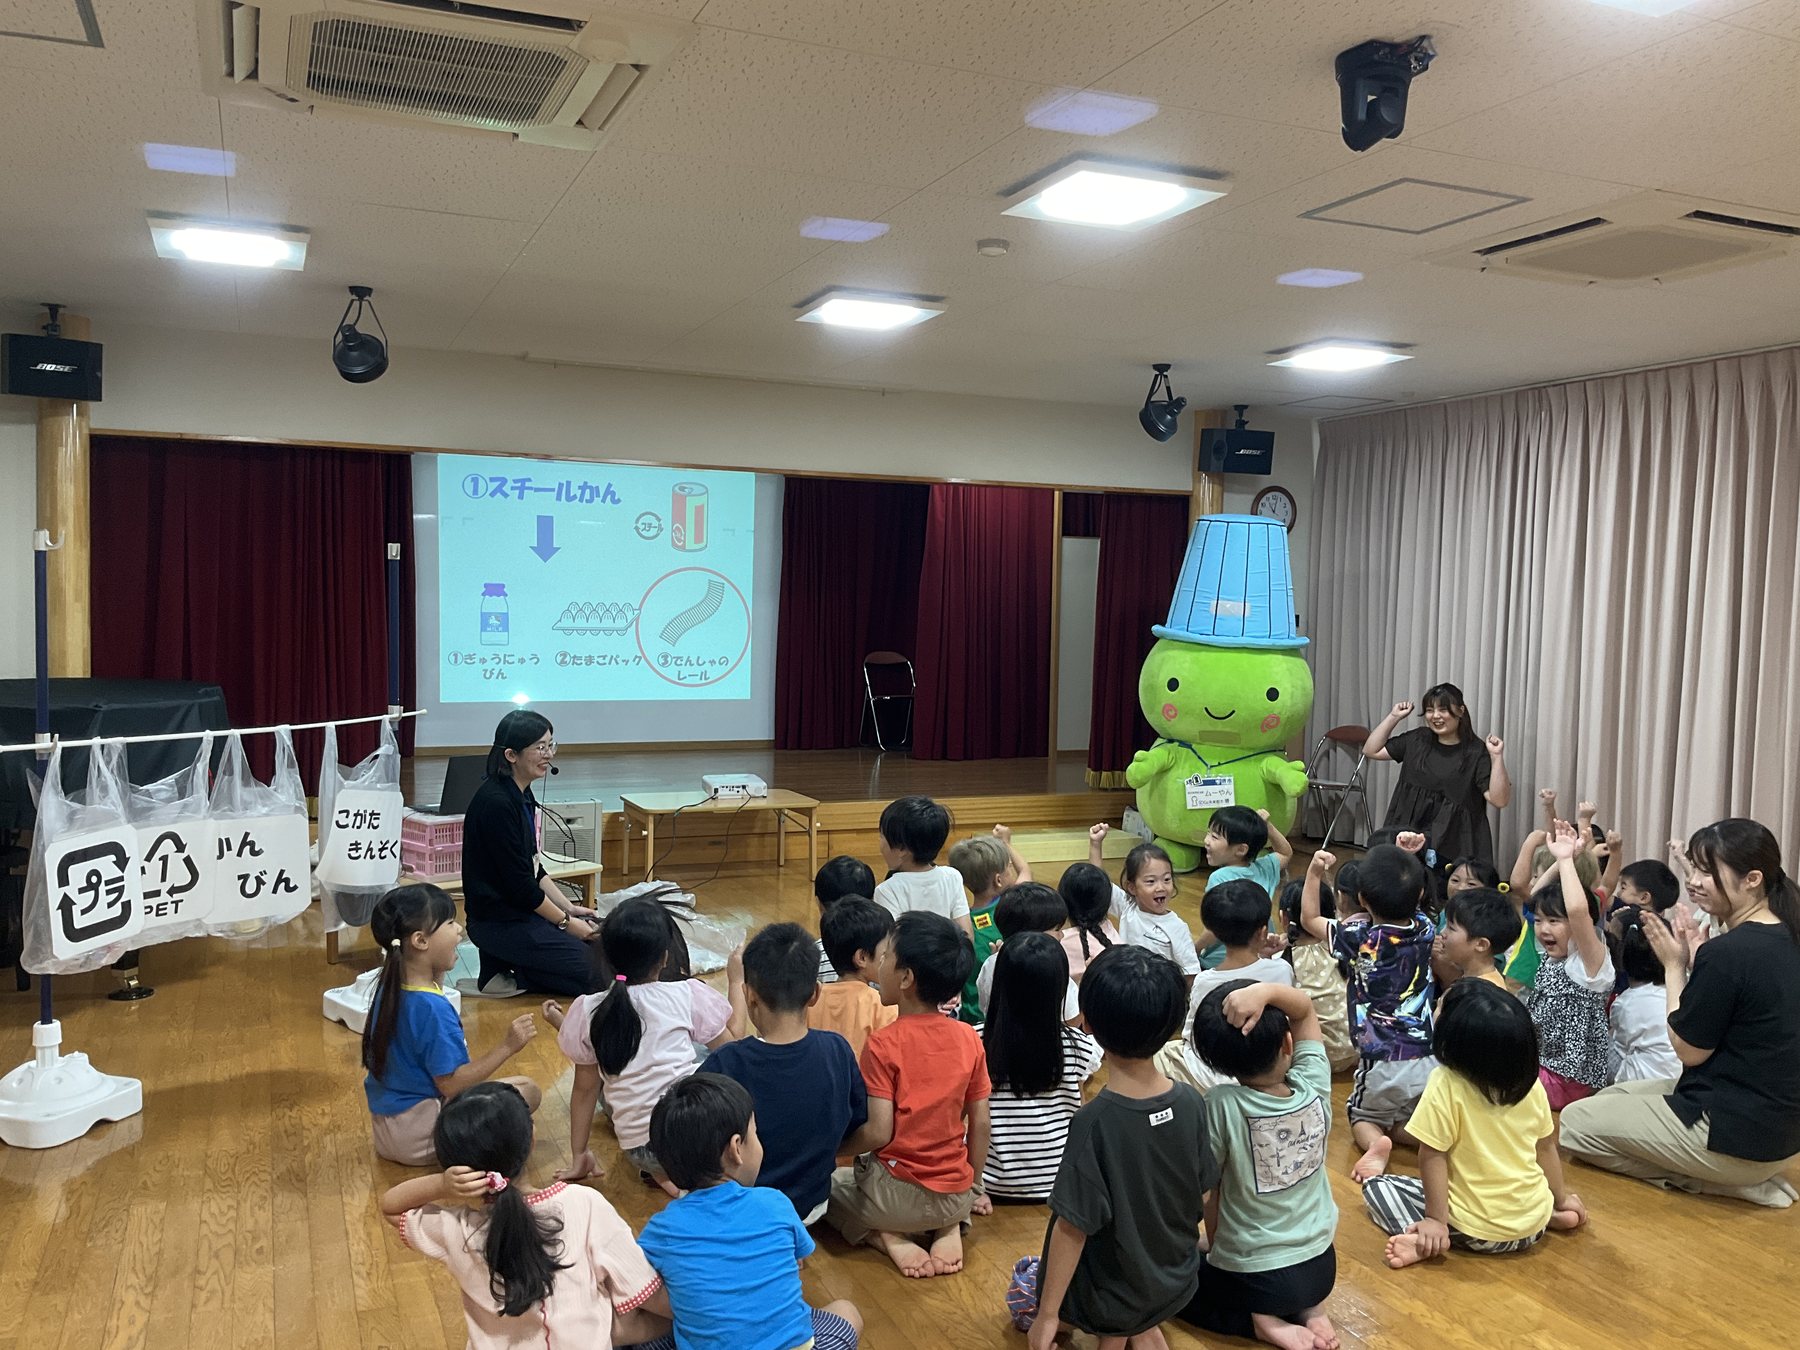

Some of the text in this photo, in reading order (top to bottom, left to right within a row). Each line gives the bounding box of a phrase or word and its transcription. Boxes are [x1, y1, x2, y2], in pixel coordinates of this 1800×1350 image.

[29, 363, 78, 372] BOSE
[482, 668, 507, 680] びん
[677, 670, 711, 681] レール
[335, 809, 381, 830] こがた
[78, 868, 125, 916] プラ
[237, 869, 299, 899] びん
